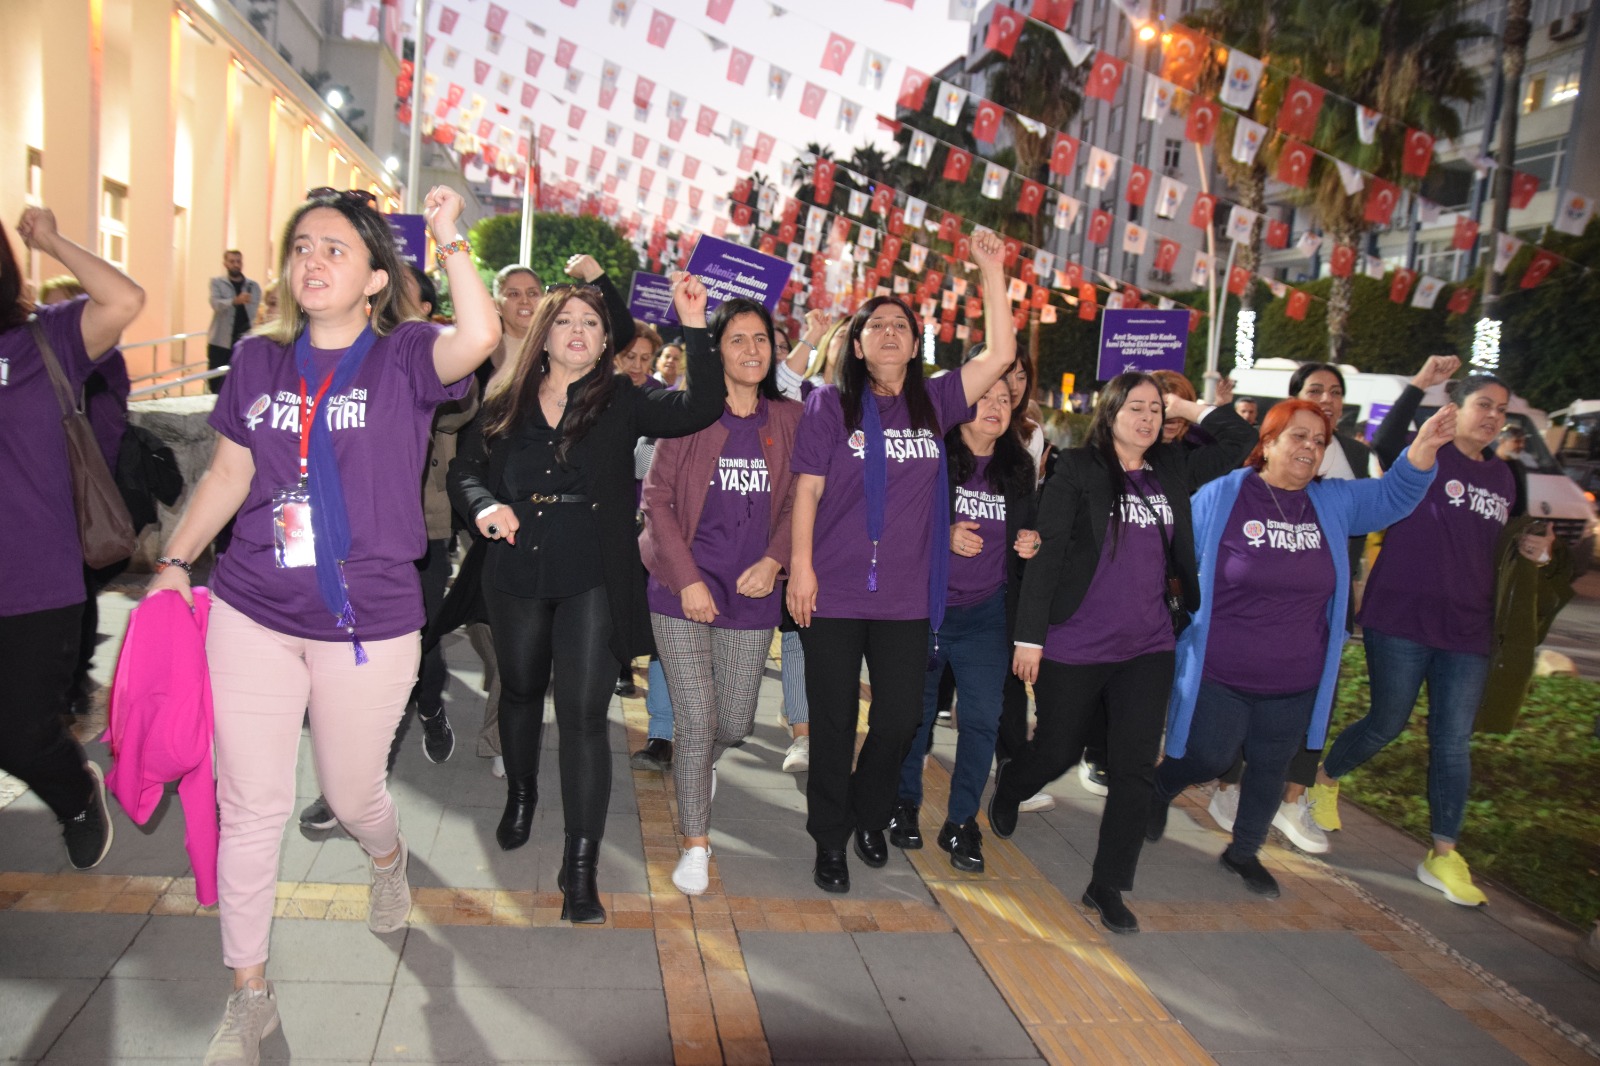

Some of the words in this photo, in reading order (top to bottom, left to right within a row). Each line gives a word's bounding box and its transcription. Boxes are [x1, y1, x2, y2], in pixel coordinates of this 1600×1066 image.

[714, 280, 754, 297] pahasına
[754, 292, 766, 301] mı
[736, 272, 768, 290] kadının
[885, 438, 940, 463] AŞATIR
